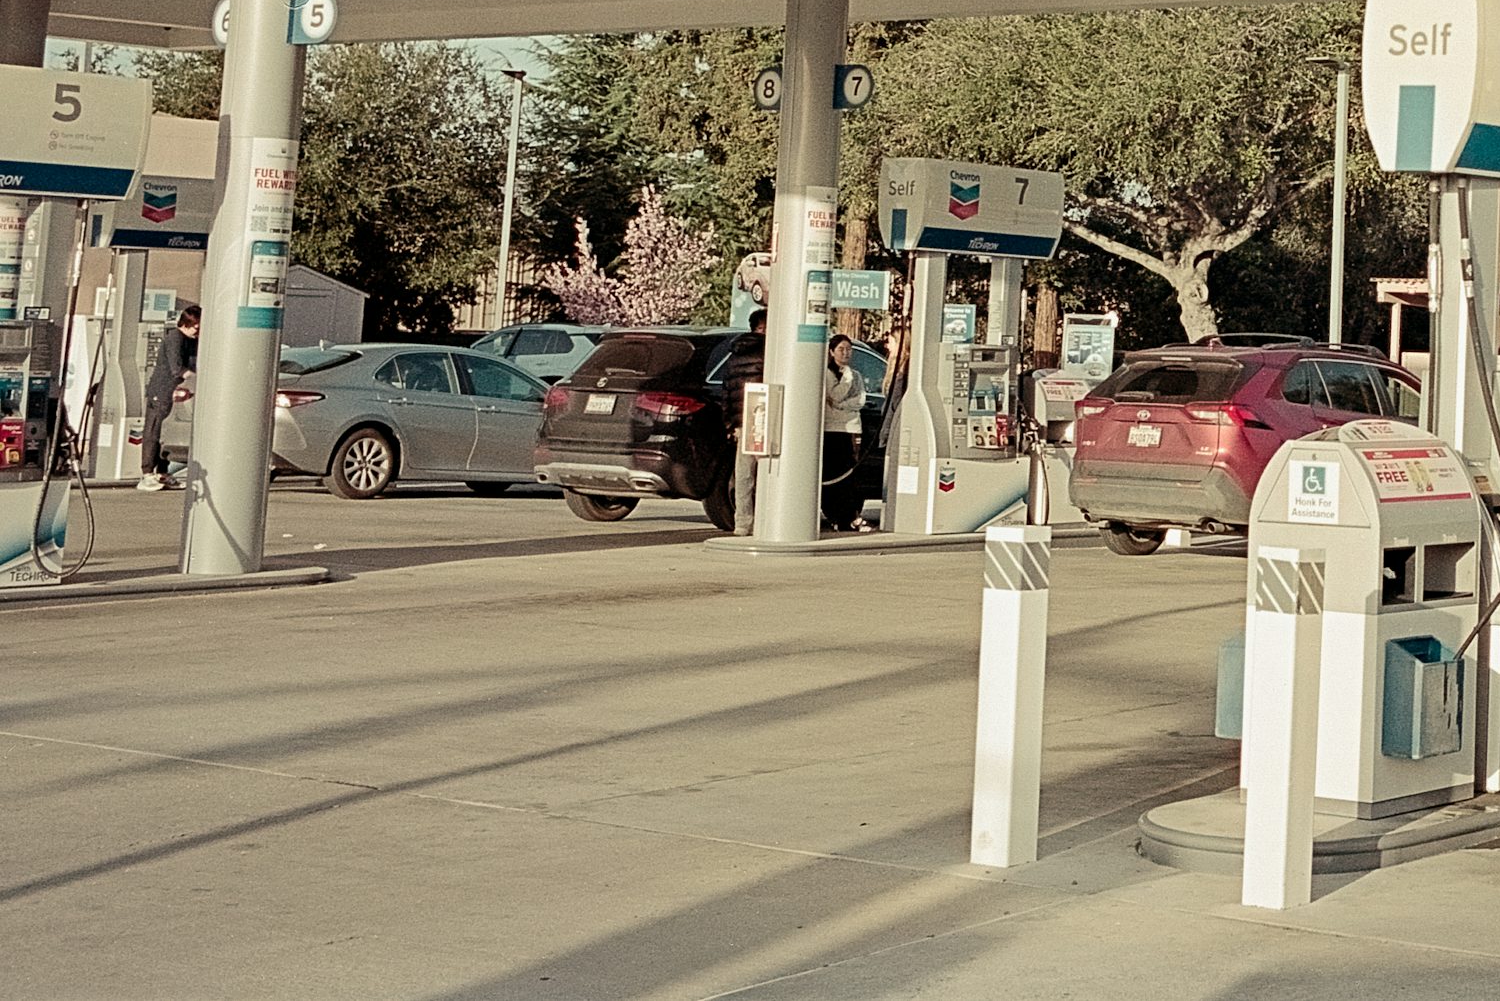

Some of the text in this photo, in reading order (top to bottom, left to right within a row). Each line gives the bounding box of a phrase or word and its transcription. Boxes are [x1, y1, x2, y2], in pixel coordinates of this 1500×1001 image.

[309, 3, 325, 28] 5
[1388, 23, 1452, 56] Self
[763, 79, 775, 98] 8
[851, 76, 863, 96] 7
[52, 83, 82, 122] 5
[254, 168, 281, 179] FUEL
[950, 170, 980, 182] Chevron
[143, 182, 177, 191] Chevron
[888, 180, 916, 196] Self
[1015, 177, 1029, 205] 7
[808, 210, 827, 219] FUEL
[168, 239, 201, 247] TECHRON
[836, 280, 880, 299] Wash
[1376, 470, 1409, 484] FREE
[1295, 498, 1332, 507] Honk For
[1291, 508, 1335, 519] Assistance
